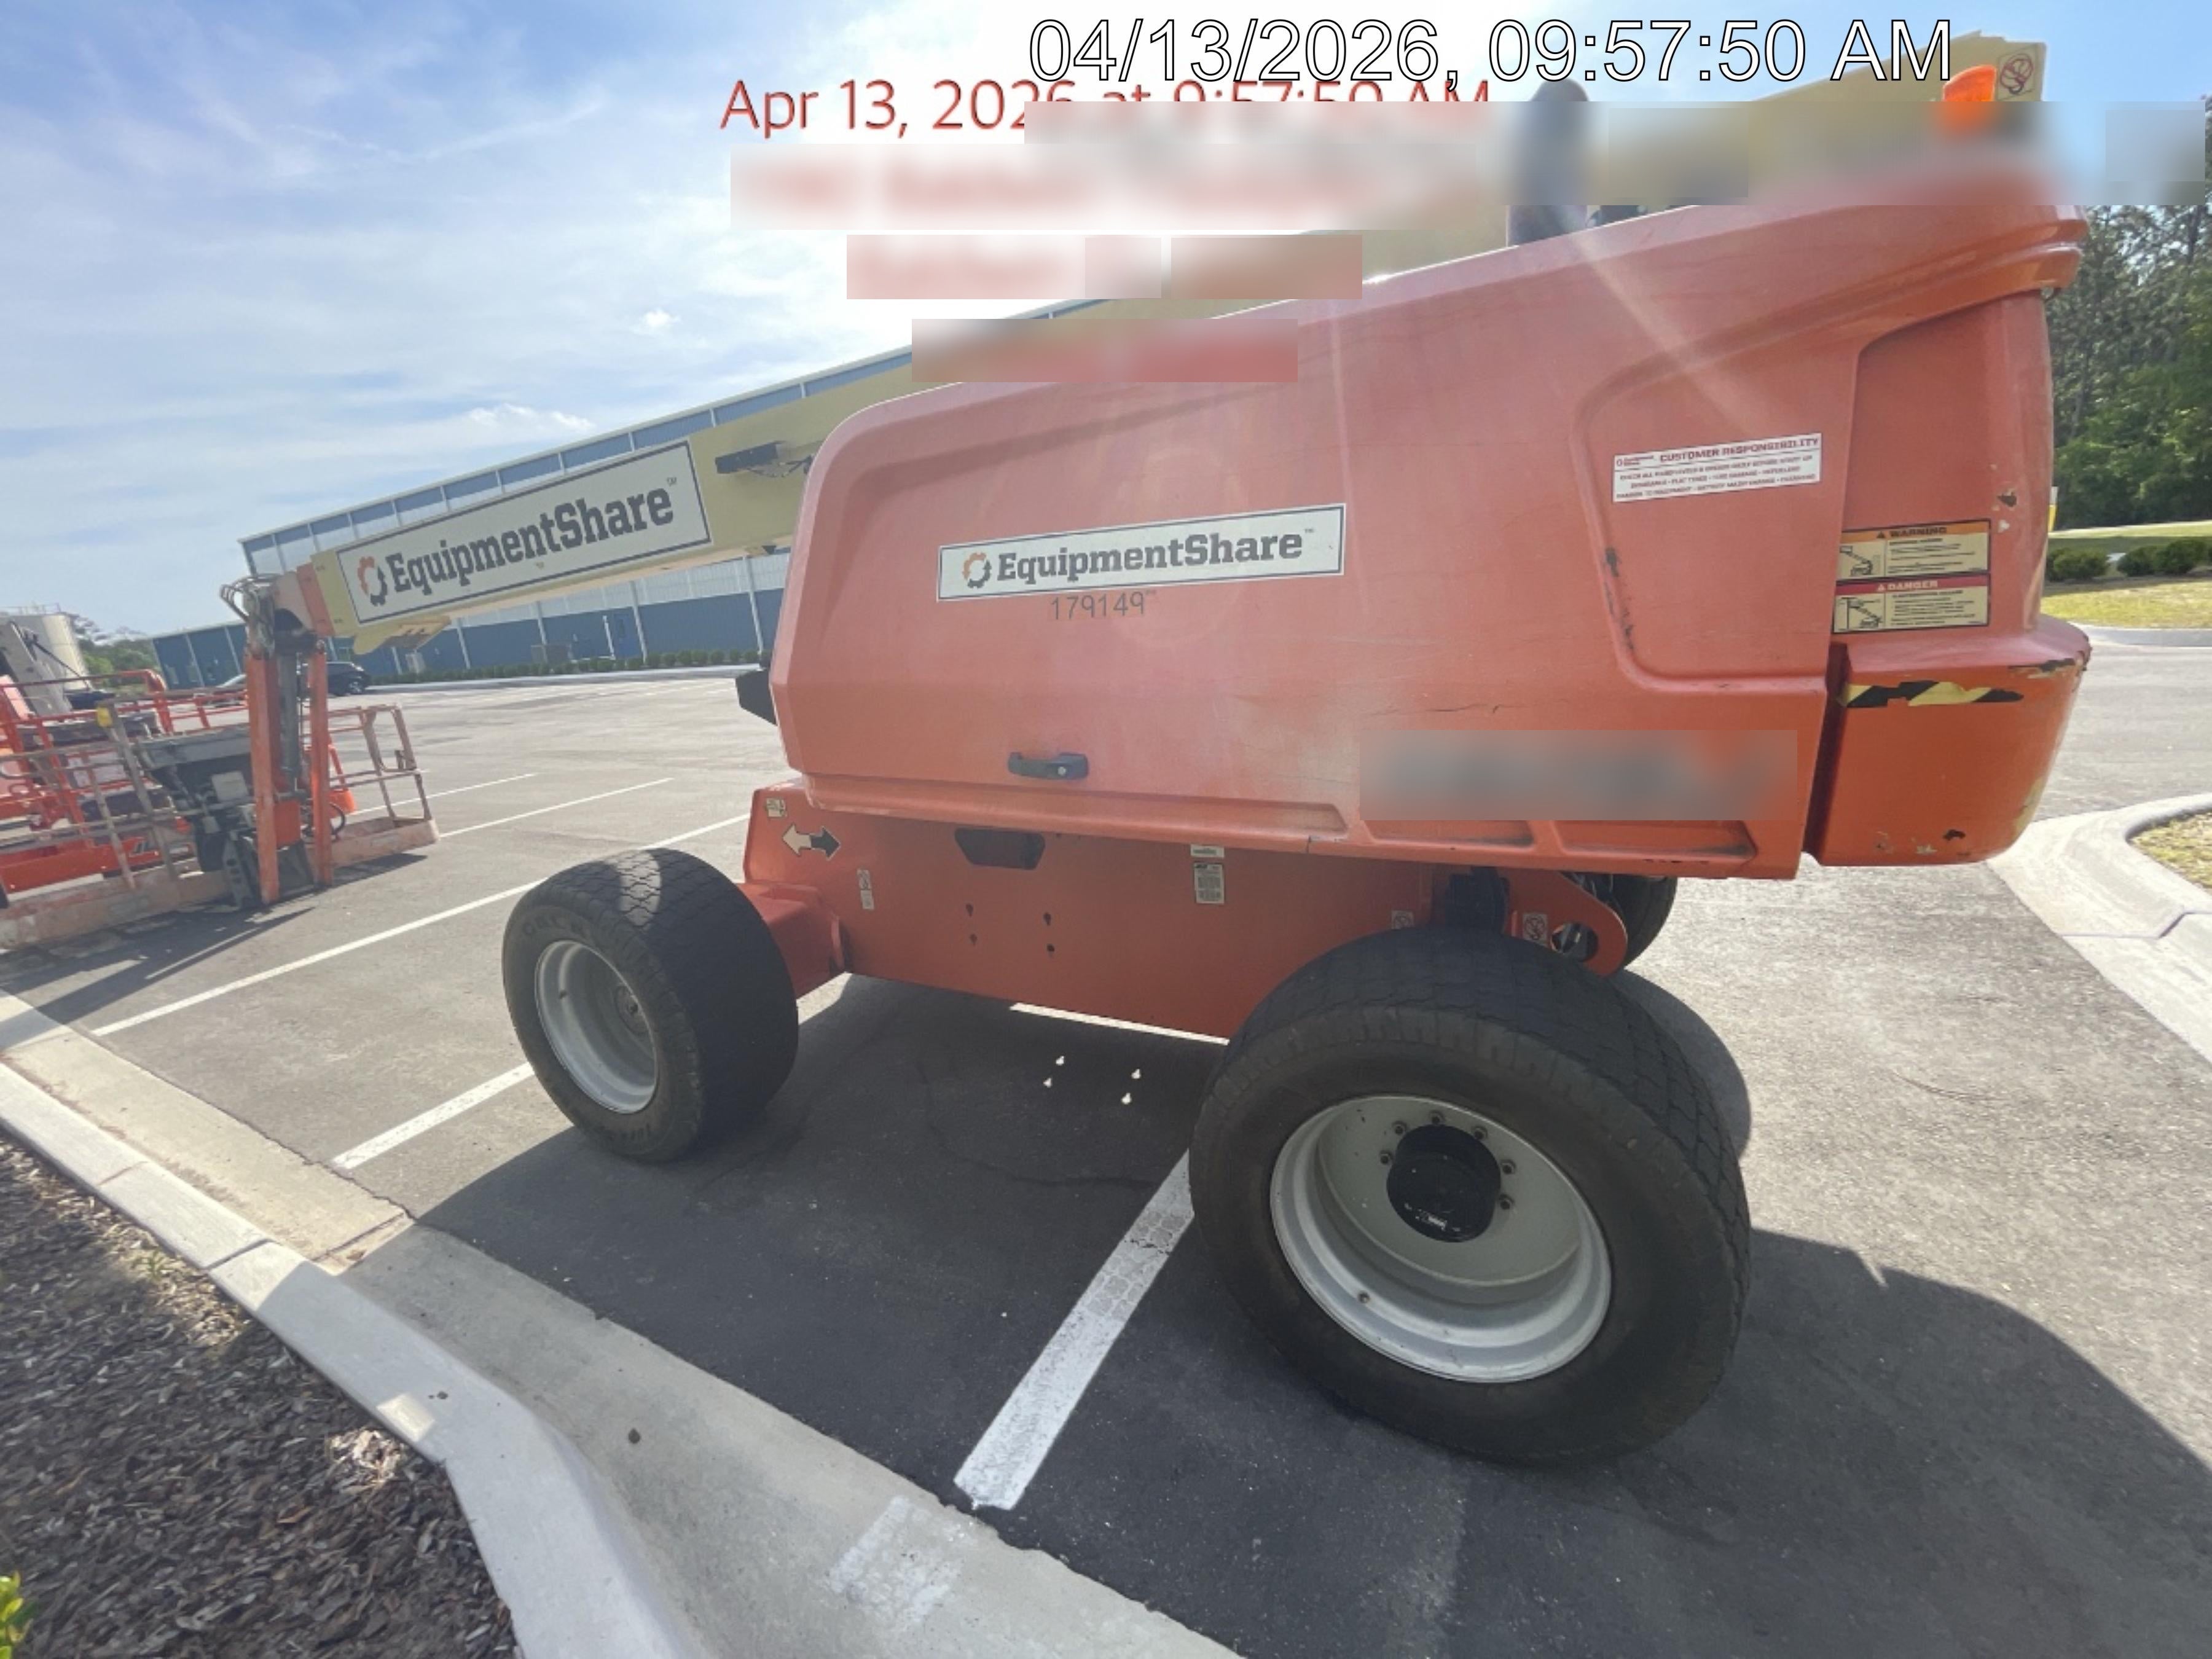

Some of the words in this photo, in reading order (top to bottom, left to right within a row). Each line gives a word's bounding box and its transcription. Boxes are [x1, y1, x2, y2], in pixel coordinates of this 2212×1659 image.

[1660, 448, 1719, 462] CUSTOMER
[1722, 438, 1818, 456] RESPONSIBILITY
[385, 487, 674, 595] EquipmentShare
[1889, 527, 1947, 538] WARNING
[997, 533, 1303, 586] EquipmentShare
[1887, 580, 1939, 591] DANGER
[1051, 591, 1145, 620] 179149
